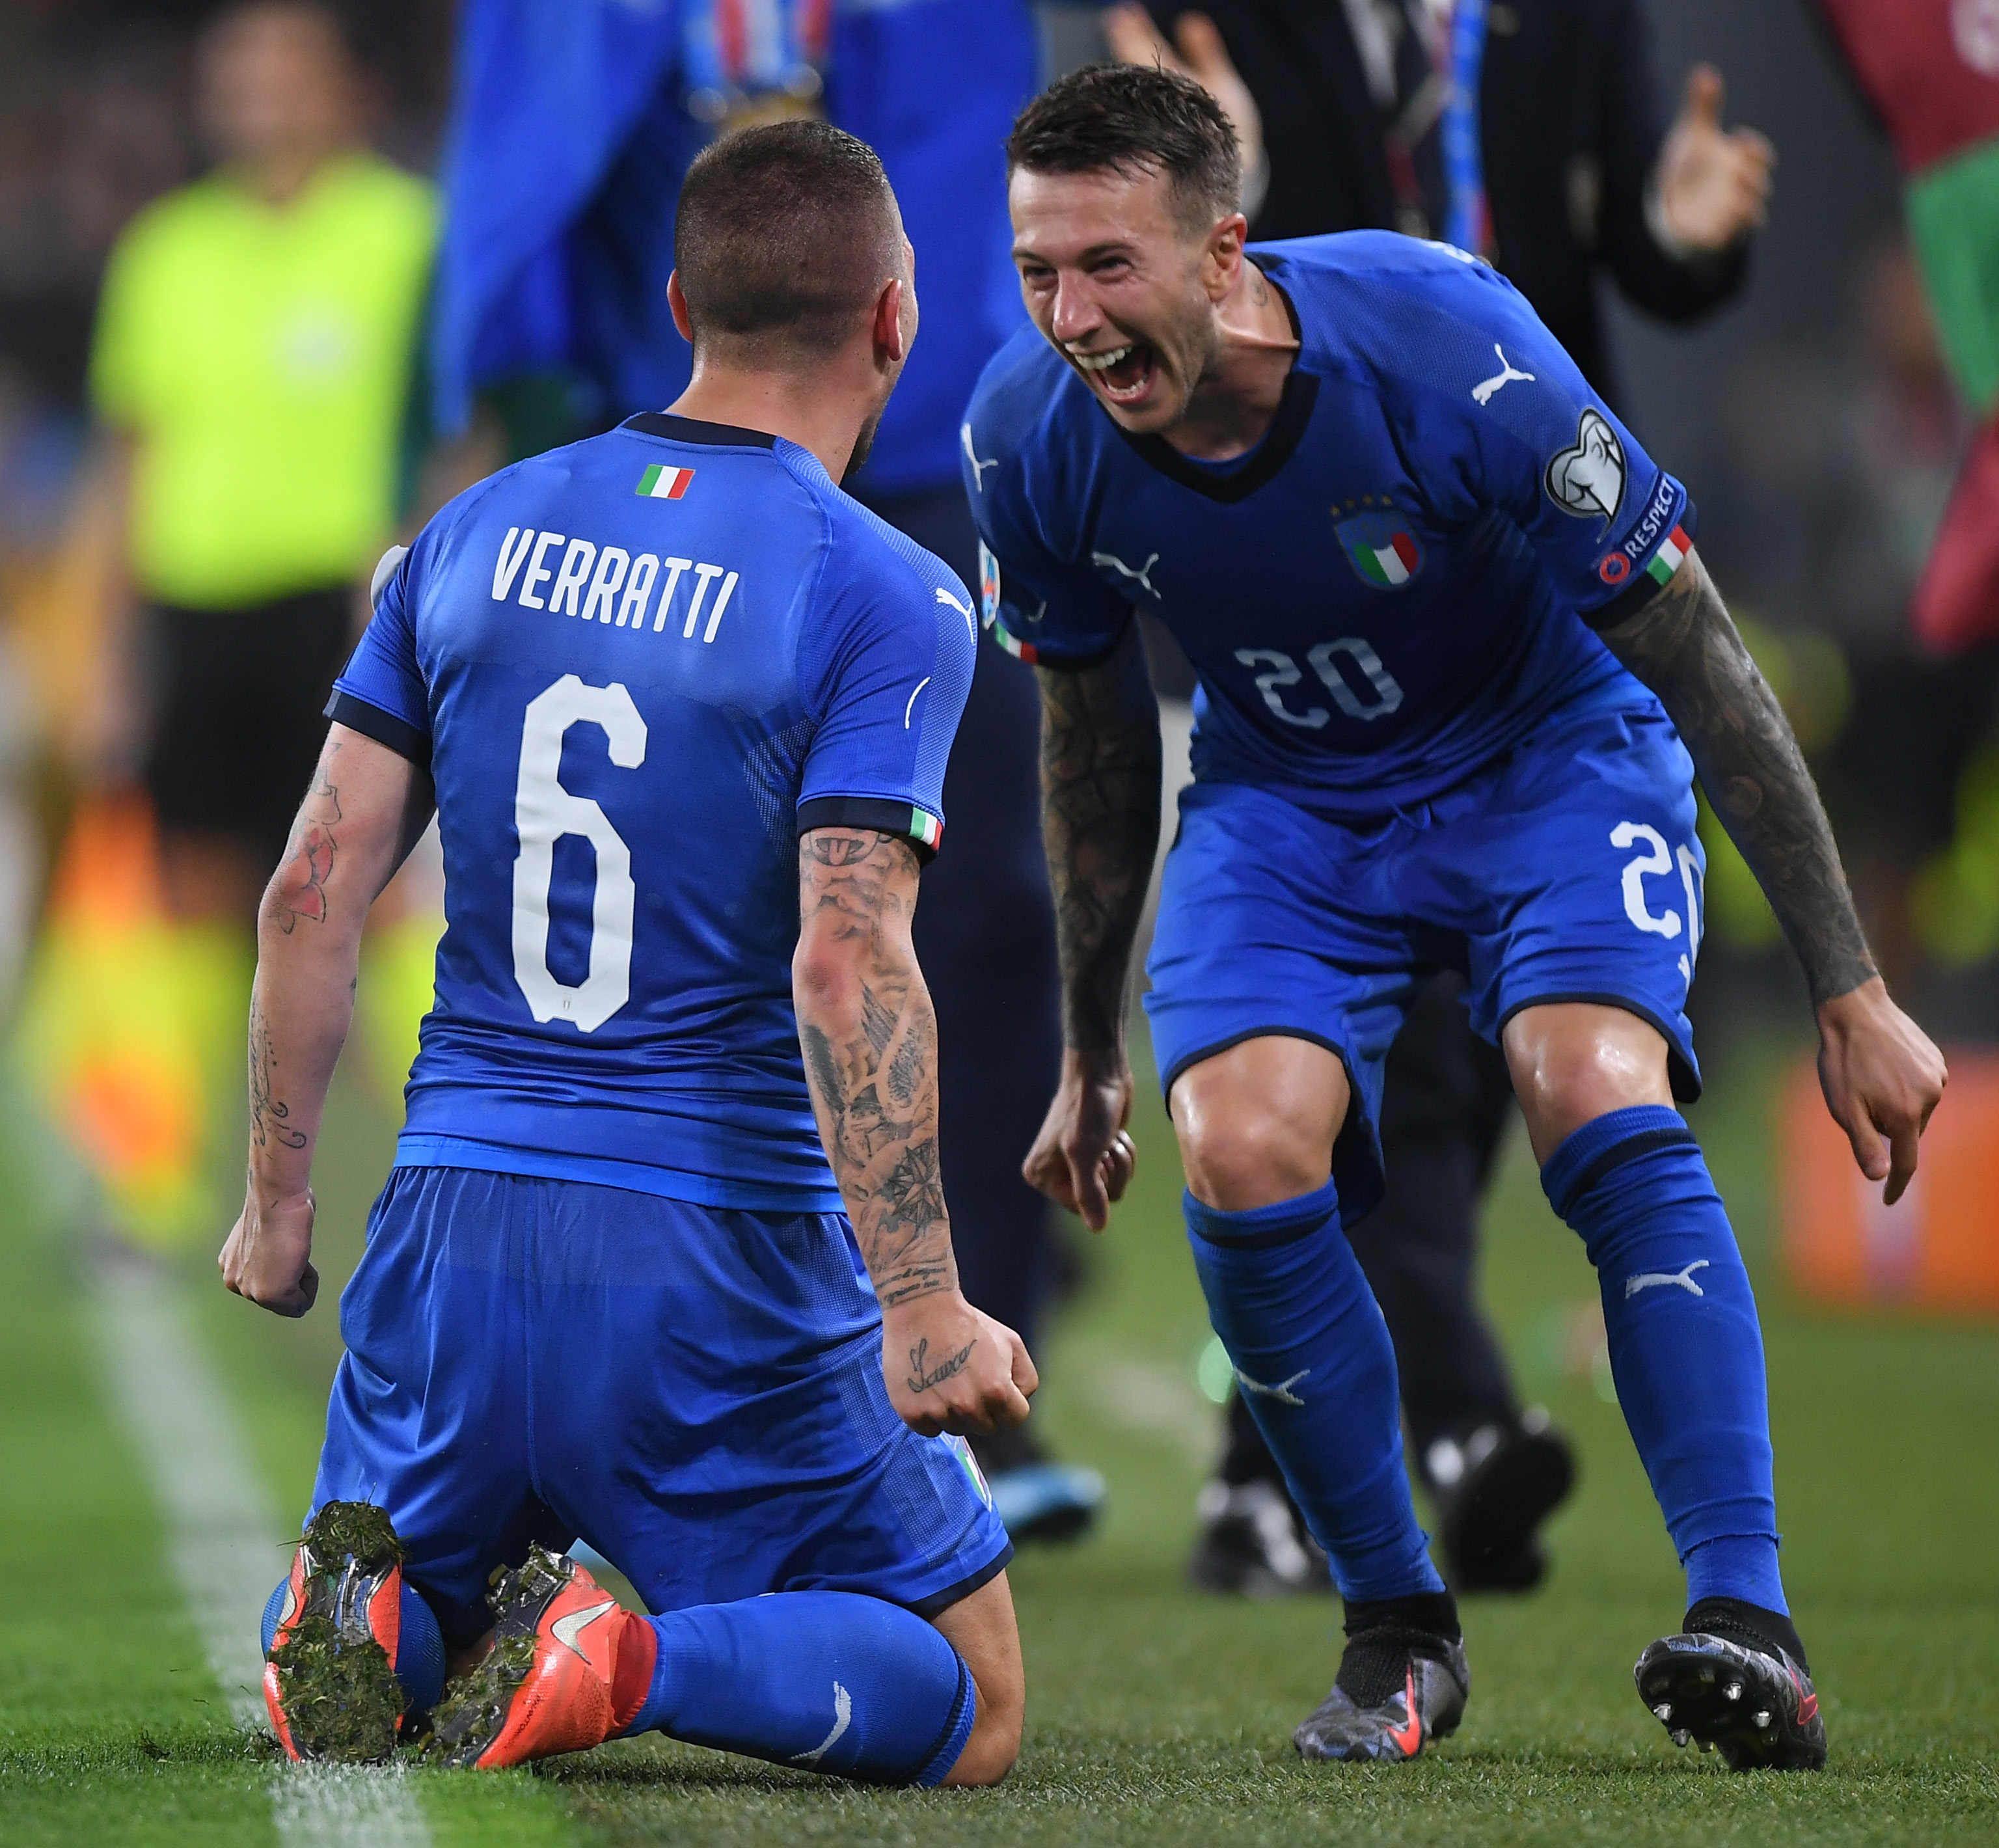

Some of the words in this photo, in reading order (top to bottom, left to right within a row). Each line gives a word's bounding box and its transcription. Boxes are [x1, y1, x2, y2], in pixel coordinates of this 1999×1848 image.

[1624, 476, 1675, 560] RESPECT
[491, 526, 739, 644] VERRATTI
[1234, 637, 1405, 729] 20
[511, 673, 648, 1033] 6
[1609, 820, 1704, 968] 20
